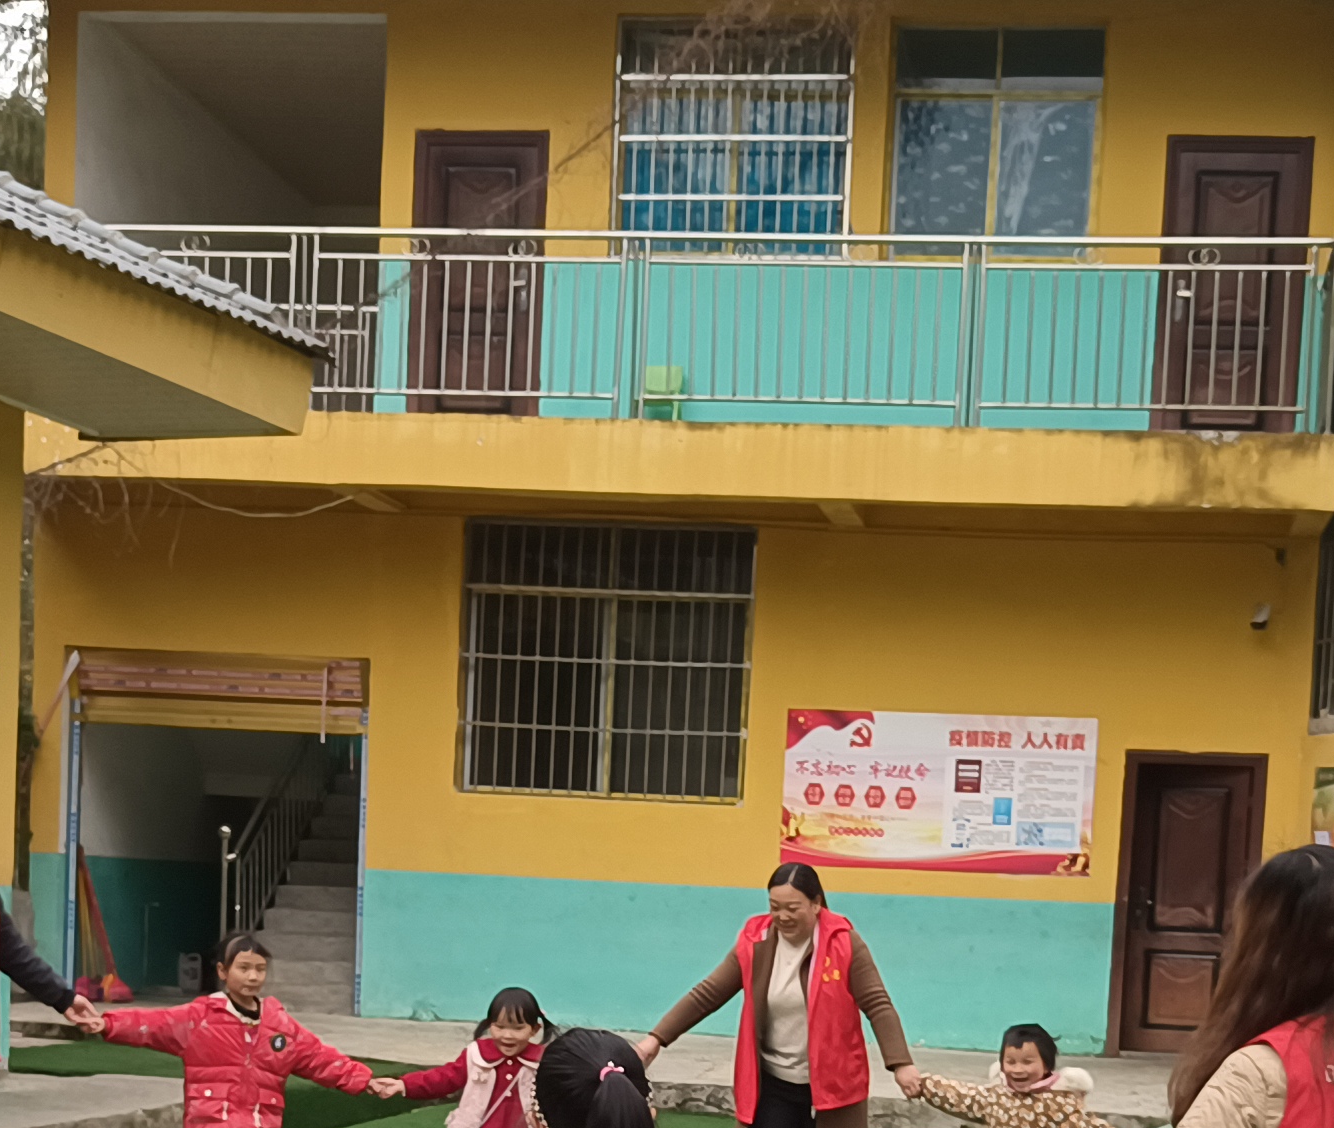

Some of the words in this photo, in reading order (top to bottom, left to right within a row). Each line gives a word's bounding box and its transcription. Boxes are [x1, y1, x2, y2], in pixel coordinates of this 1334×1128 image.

[949, 730, 1012, 749] 疫情防控
[1021, 731, 1086, 751] 人人有责
[795, 759, 856, 776] 不忘初心
